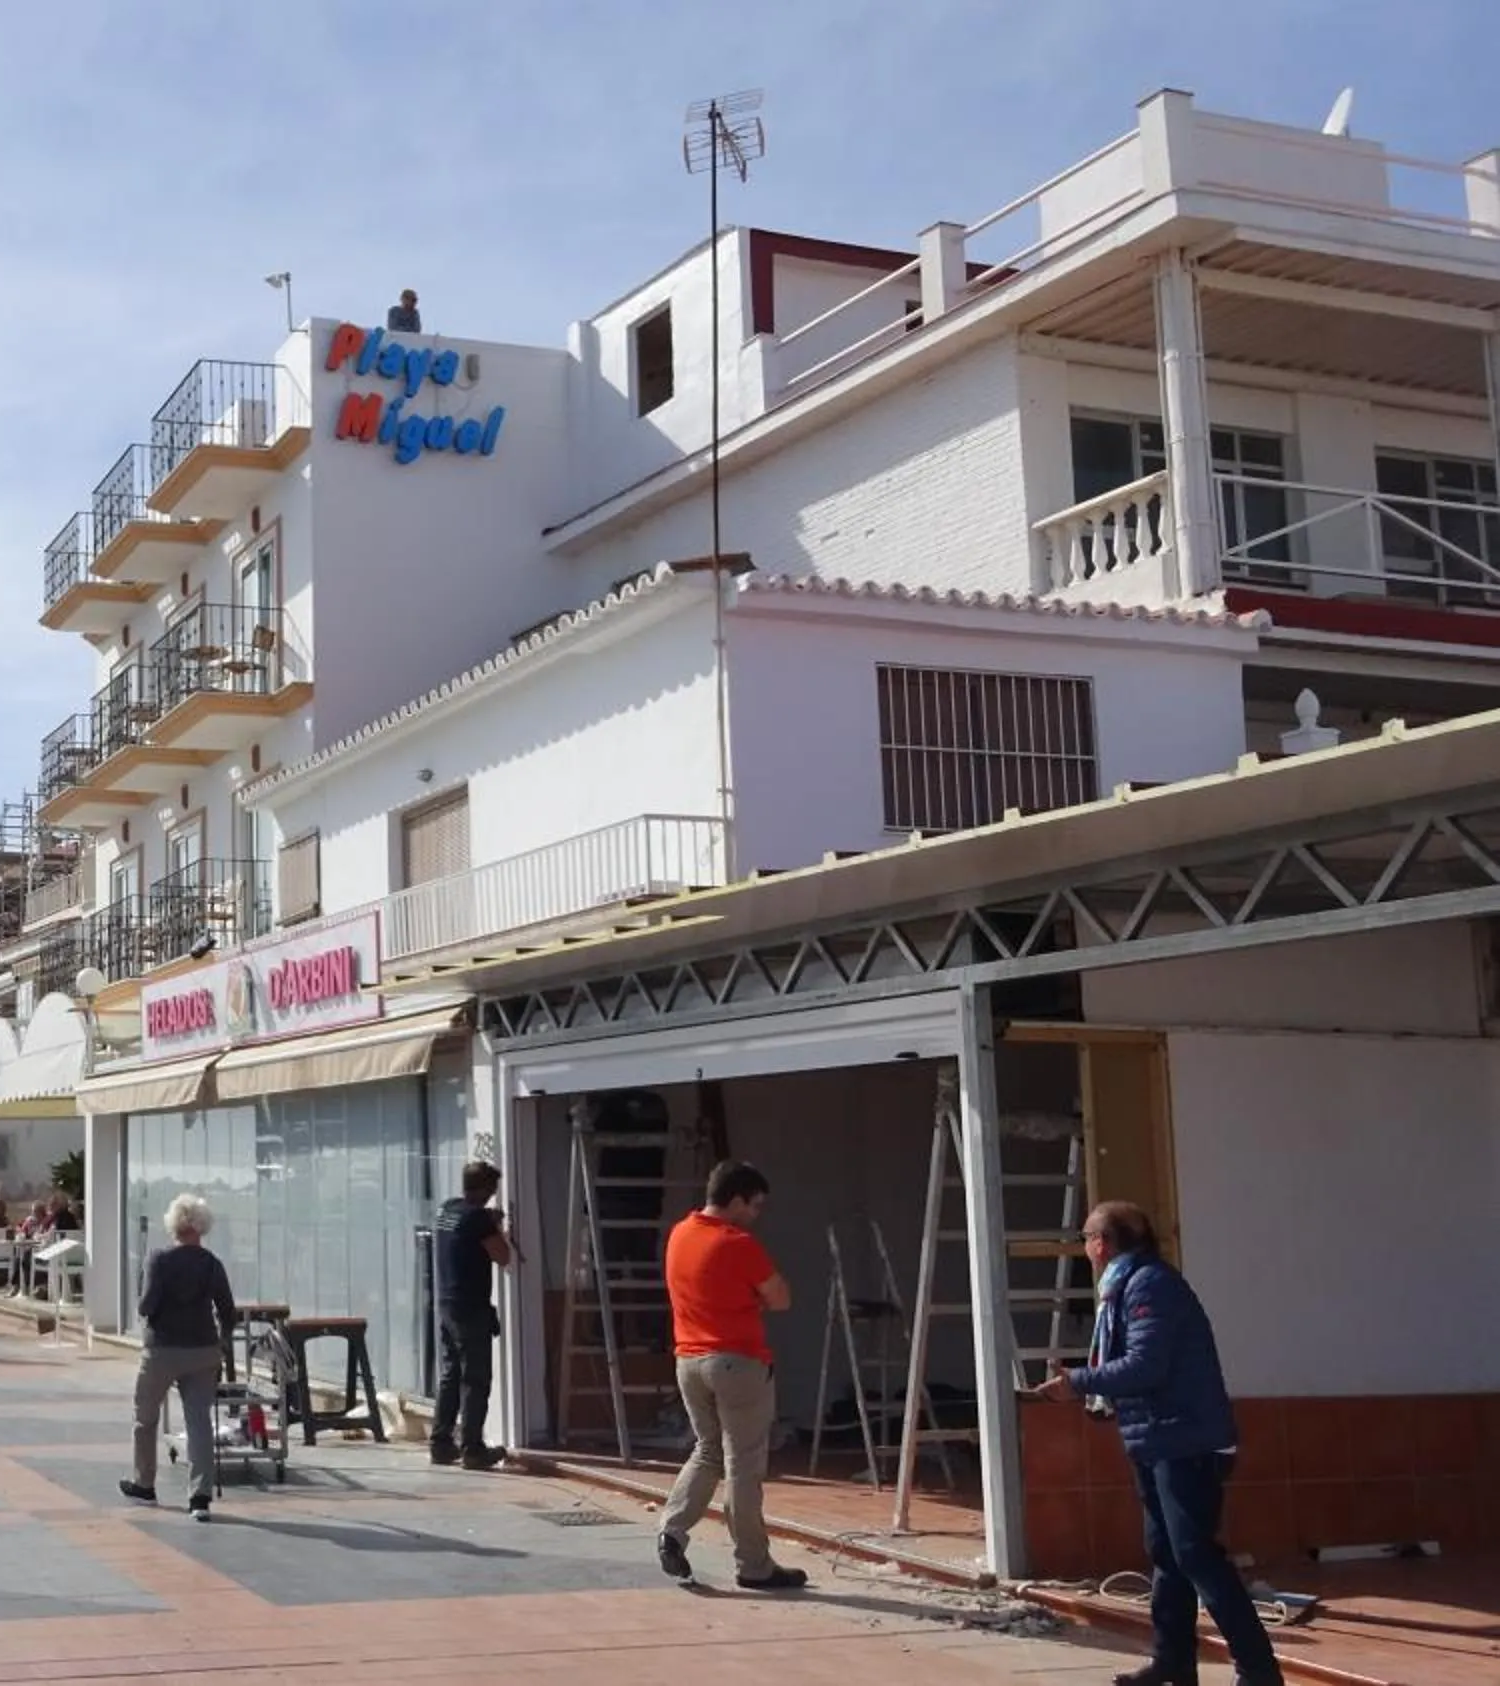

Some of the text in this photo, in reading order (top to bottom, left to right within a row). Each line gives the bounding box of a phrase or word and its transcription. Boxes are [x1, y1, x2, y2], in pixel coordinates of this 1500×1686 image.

[325, 323, 459, 397] Playa
[335, 391, 506, 464] Miguel
[147, 989, 216, 1037] HELADOS
